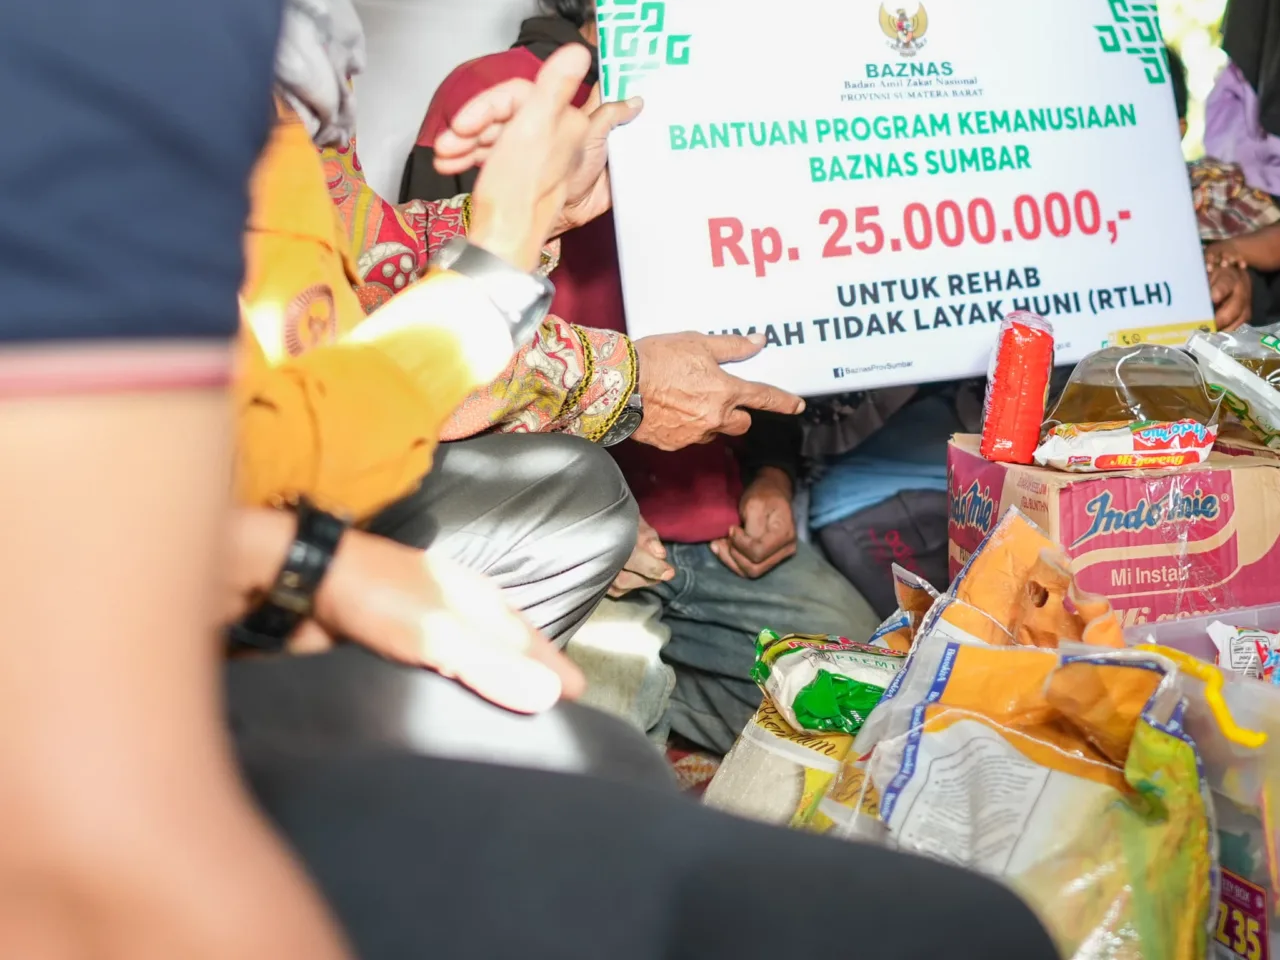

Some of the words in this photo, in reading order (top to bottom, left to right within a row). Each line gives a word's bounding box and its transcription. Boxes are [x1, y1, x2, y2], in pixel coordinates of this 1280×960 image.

[844, 80, 875, 89] Badan
[906, 77, 932, 87] Zakat
[936, 76, 978, 86] Nasional
[865, 61, 954, 78] BAZNAS
[840, 91, 890, 102] PROVINSI
[952, 88, 984, 98] BARAT
[668, 119, 809, 151] BANTUAN
[815, 113, 951, 143] PROGRAM
[957, 103, 1138, 136] KEMANUSIAAN
[809, 151, 918, 183] BAZNAS
[924, 144, 1032, 175] SUMBAR
[707, 216, 800, 278] Rp.
[818, 189, 1132, 258] 25.000.000,-
[836, 276, 941, 308] UNTUK
[947, 266, 1041, 297] REHAB
[812, 310, 906, 343] TIDAK
[914, 299, 1005, 331] LAYAK
[1012, 291, 1081, 317] HUNI
[1088, 281, 1172, 315] (RTLH)
[1111, 453, 1134, 466] Mi
[1135, 453, 1184, 467] goreng
[1069, 489, 1220, 549] Indomie
[1111, 568, 1132, 587] Mi
[1136, 565, 1190, 584] Instan
[835, 654, 898, 670] PREMI
